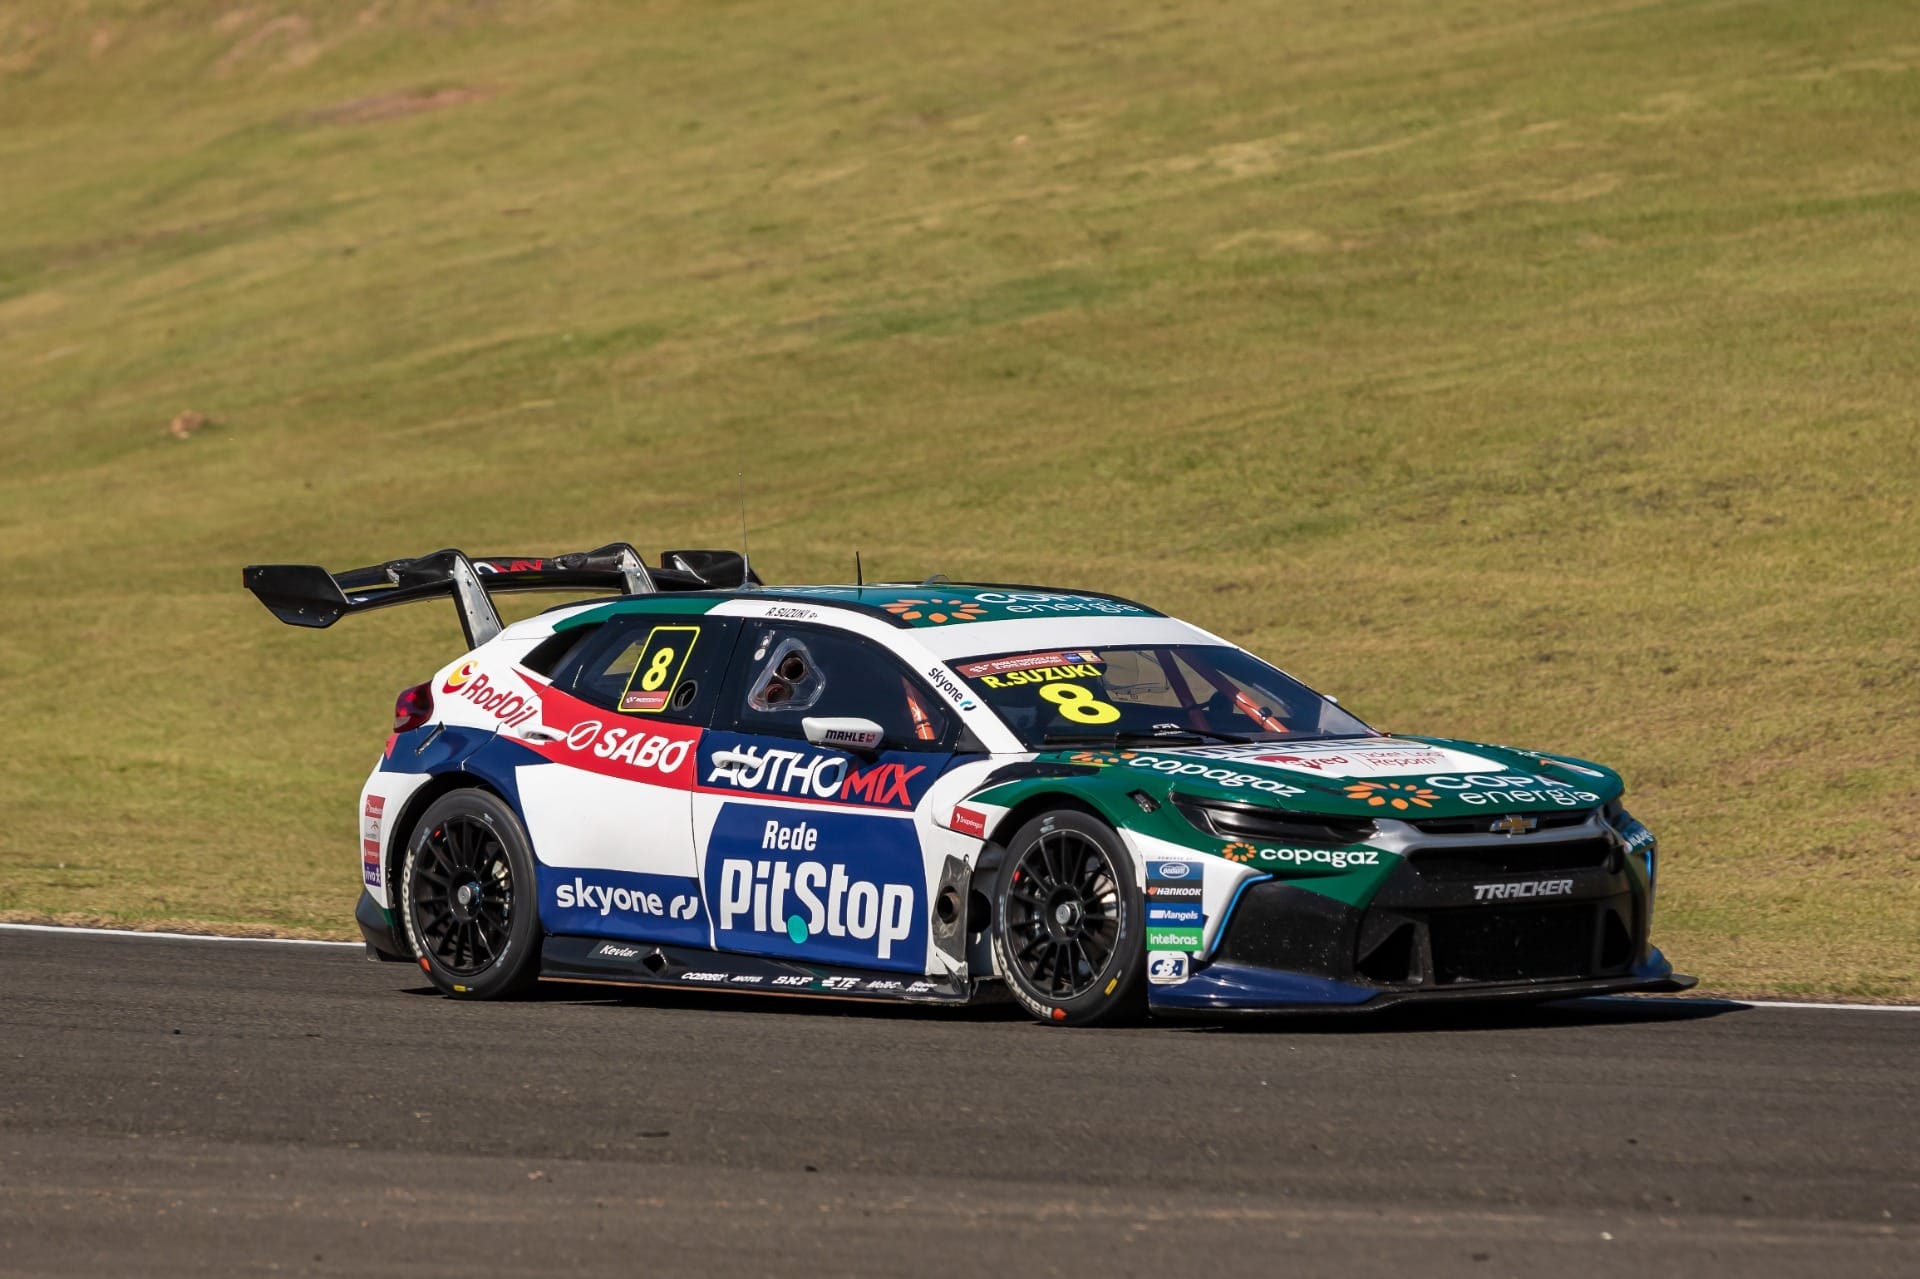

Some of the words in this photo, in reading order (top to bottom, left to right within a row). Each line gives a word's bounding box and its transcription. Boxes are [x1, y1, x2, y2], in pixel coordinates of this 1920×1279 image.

[1006, 602, 1144, 614] energia
[641, 647, 675, 692] 8
[980, 664, 1102, 688] R.SUZUKI
[928, 667, 963, 702] skyone
[461, 673, 538, 728] RodOil
[1039, 683, 1120, 725] 8
[825, 729, 866, 743] MAHLE
[707, 744, 927, 806] AUTHOMIX
[1128, 756, 1306, 797] copagaz
[1425, 774, 1575, 789] COPA
[1458, 789, 1601, 806] energia
[762, 820, 818, 851] Rede
[1260, 849, 1379, 868] copagaz
[556, 877, 664, 916] skyone
[1473, 879, 1574, 900] TRACKER
[720, 859, 914, 960] PitStop
[1163, 910, 1198, 921] Mangels
[1150, 934, 1198, 945] intelbras
[599, 944, 639, 958] Kevlar
[771, 976, 814, 986] SKF
